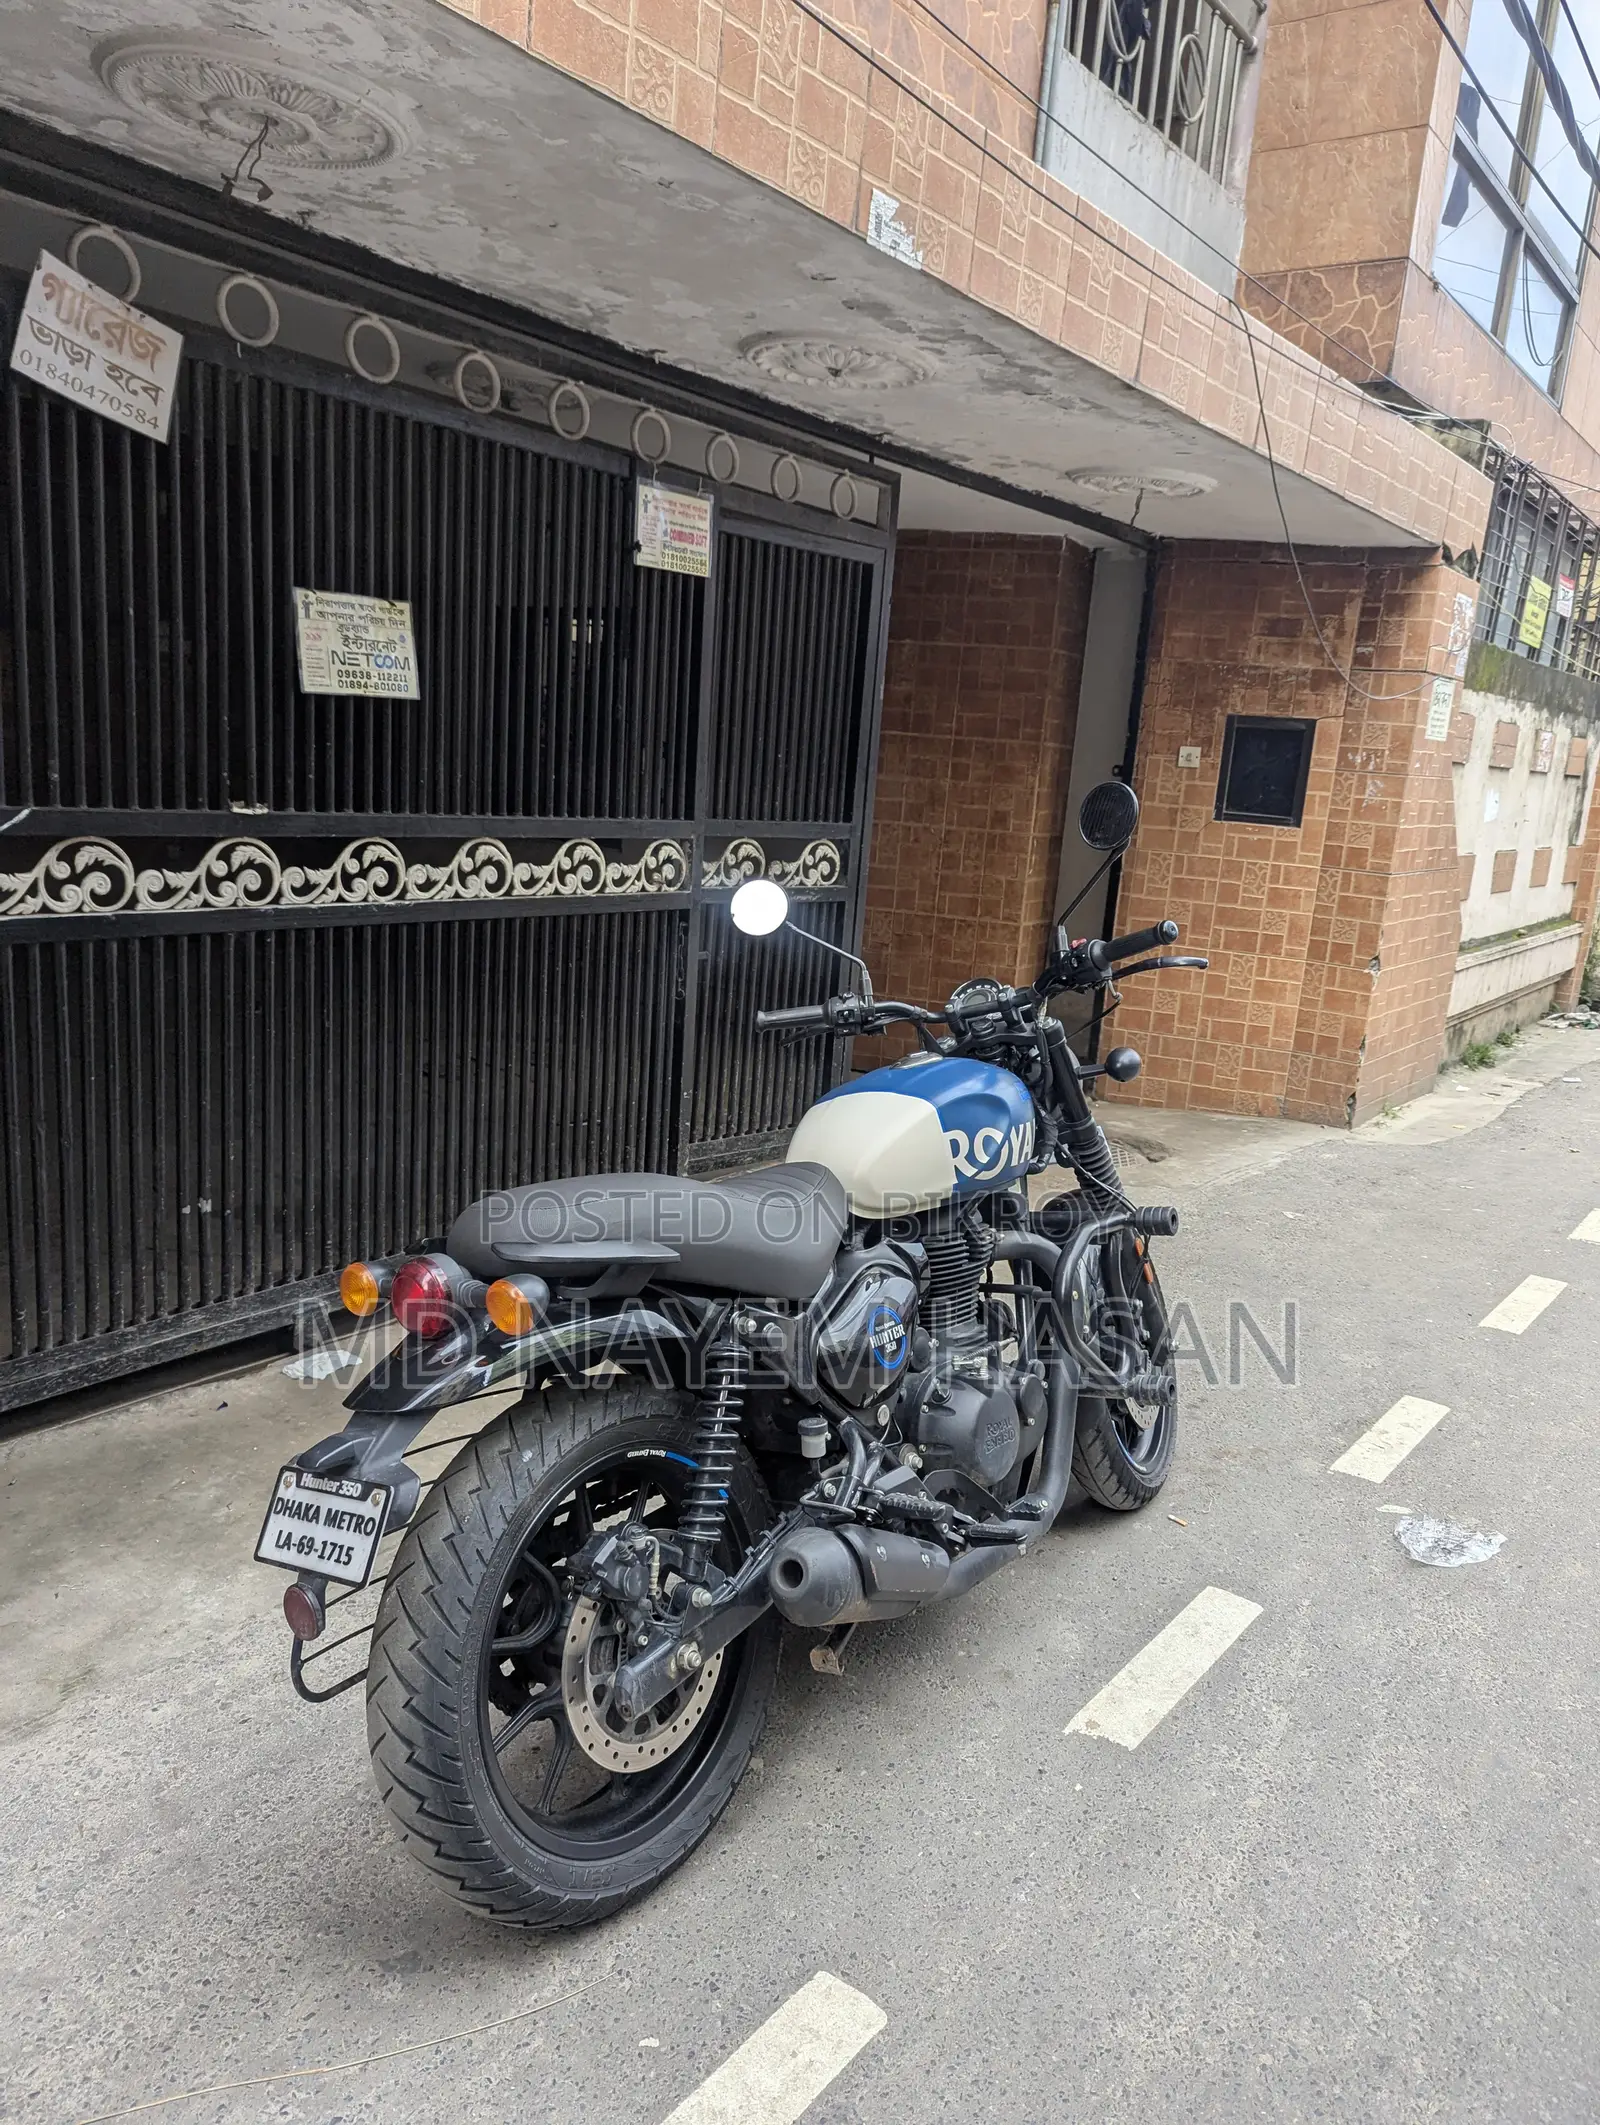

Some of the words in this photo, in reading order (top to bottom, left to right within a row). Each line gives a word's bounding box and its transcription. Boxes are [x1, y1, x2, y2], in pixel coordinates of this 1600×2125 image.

[27, 314, 96, 372] ভাড়া
[102, 357, 165, 407] হবে
[19, 349, 160, 430] 01840470584
[331, 650, 411, 671] NETCOM
[337, 669, 408, 683] 09638-112211
[869, 1324, 906, 1350] HUNTER
[300, 1473, 340, 1493] Hunter
[339, 1480, 362, 1498] 350
[273, 1497, 321, 1525] DHAKA
[323, 1507, 376, 1537] METRO
[275, 1529, 354, 1566] LA-69-1715
